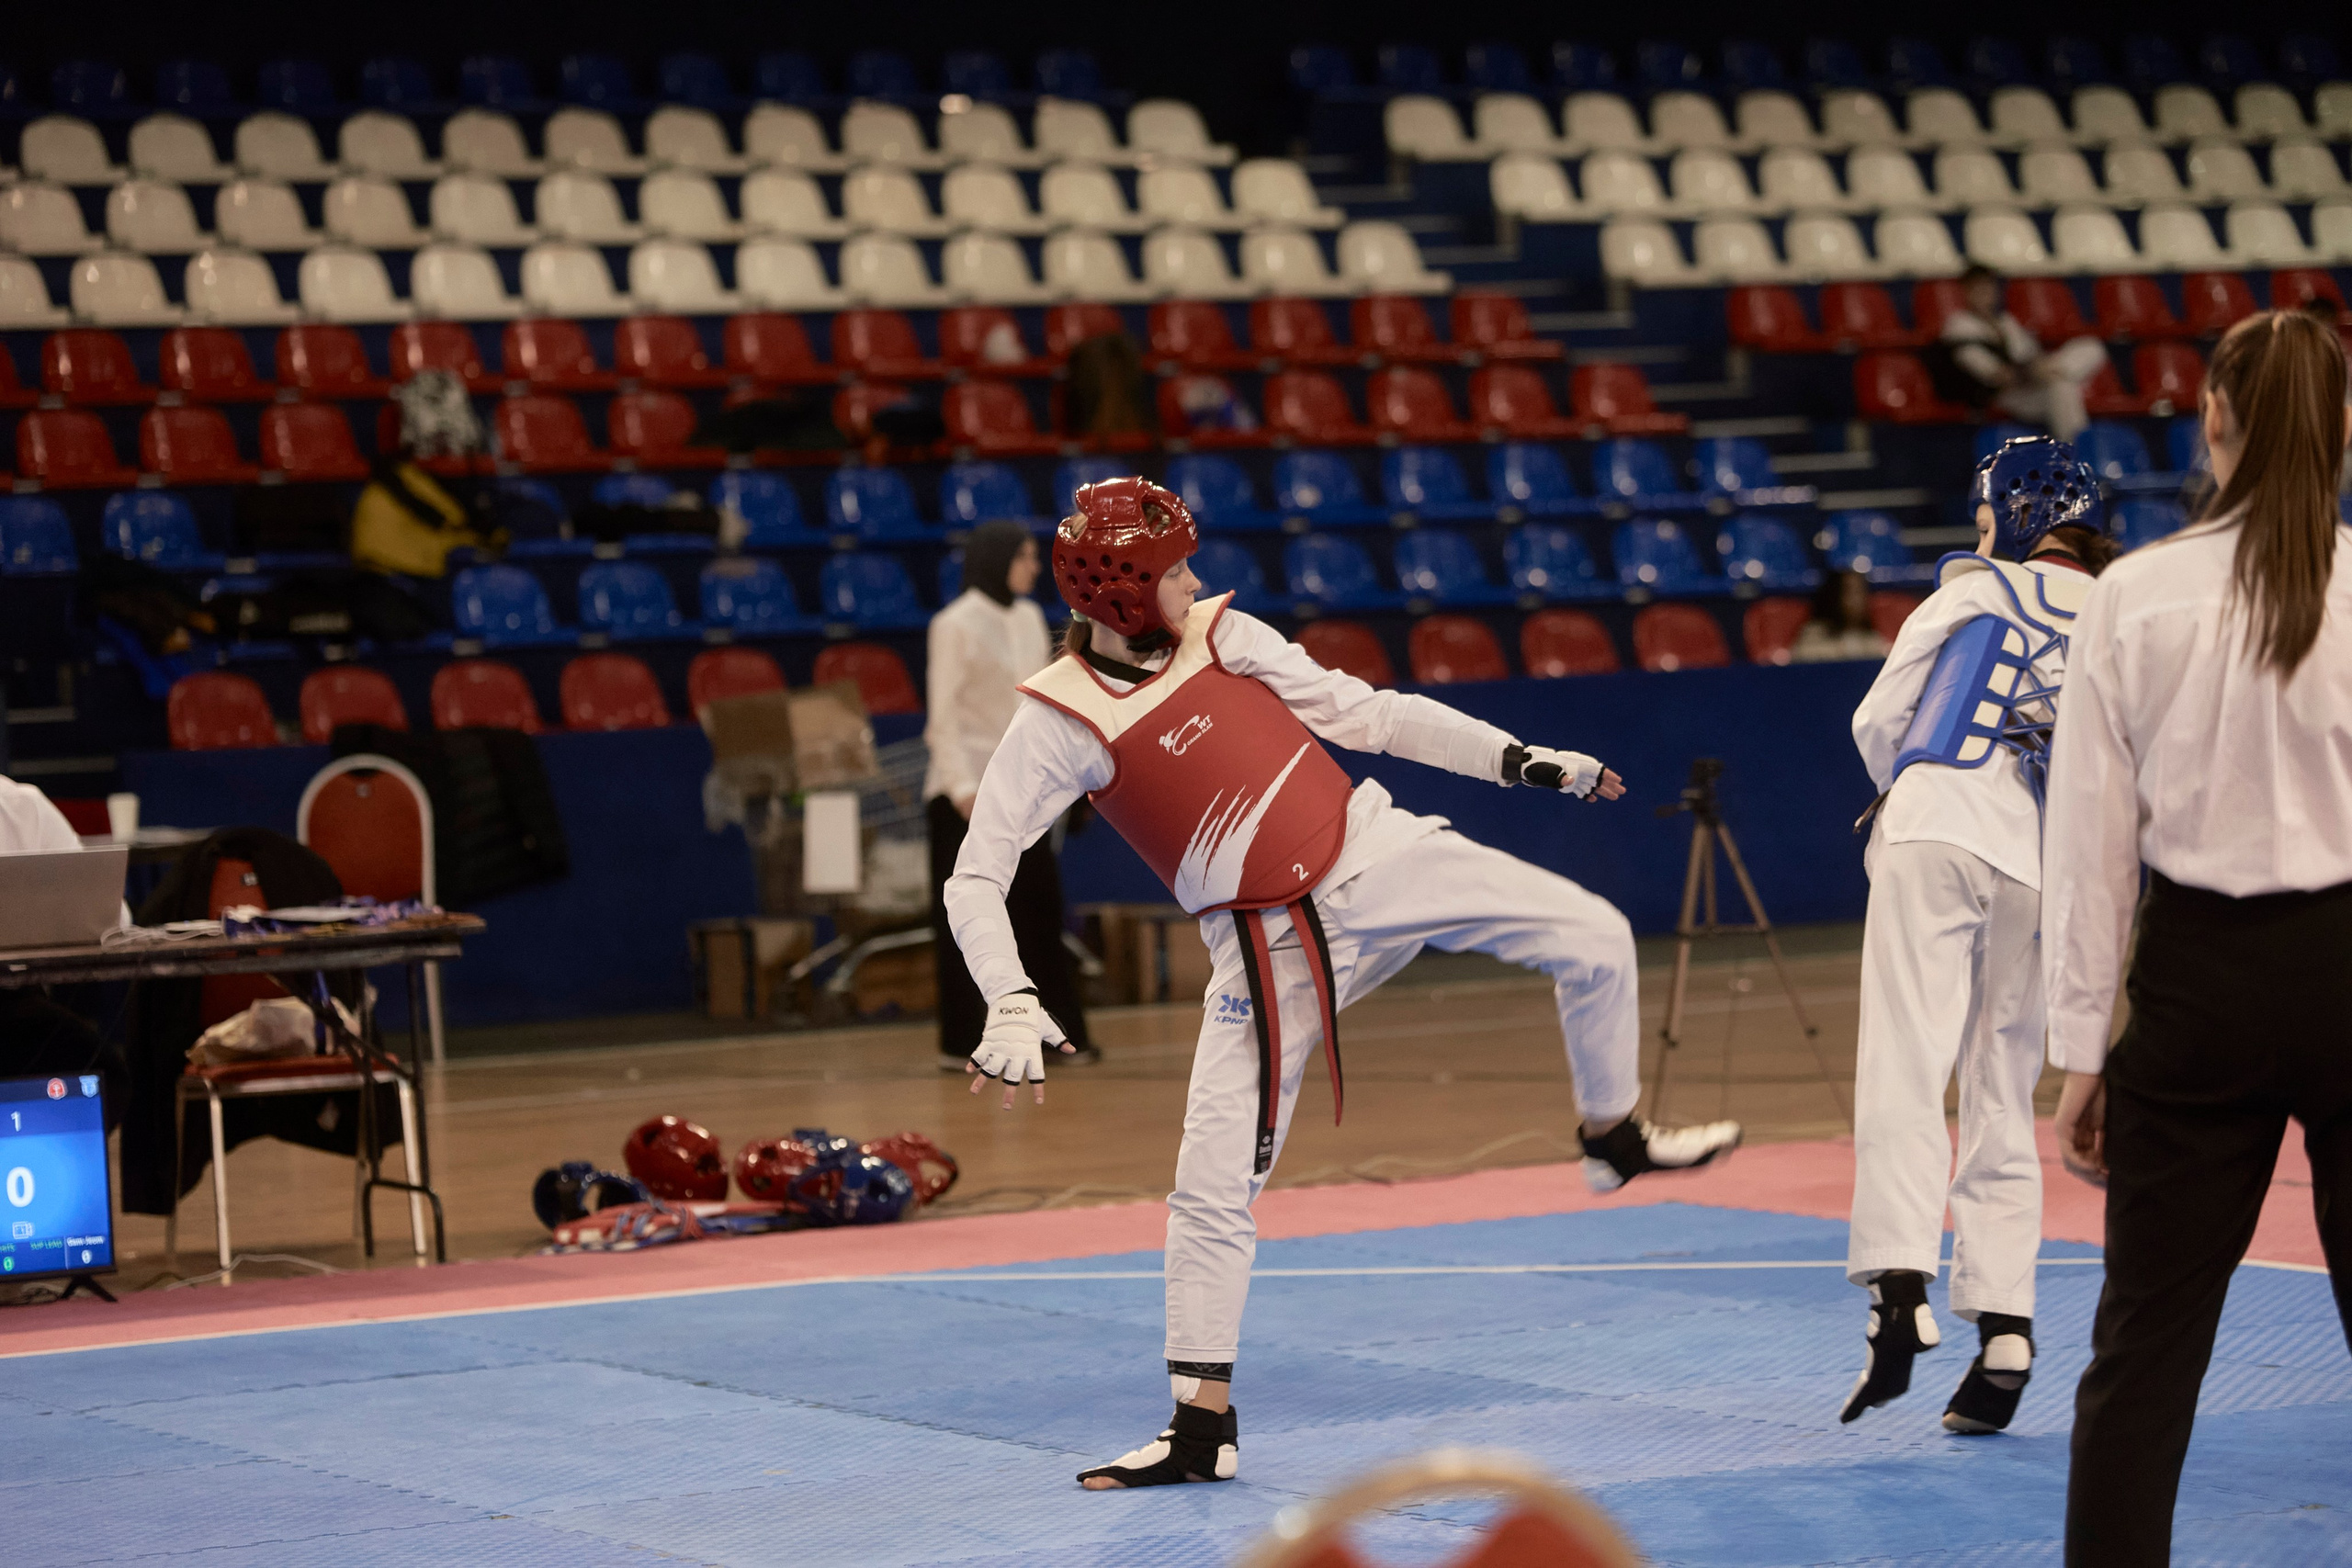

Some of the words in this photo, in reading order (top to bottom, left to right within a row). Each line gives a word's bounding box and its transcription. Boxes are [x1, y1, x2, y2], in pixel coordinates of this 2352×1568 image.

[1197, 715, 1210, 729] WT
[1187, 732, 1202, 746] GRAND
[1202, 722, 1213, 734] SLAM
[1292, 863, 1310, 882] 2
[999, 1007, 1029, 1015] KWON
[1214, 1015, 1248, 1024] KPNP
[11, 1111, 21, 1132] 1
[6, 1167, 35, 1208] 0
[3, 1257, 14, 1271] 0
[81, 1250, 92, 1264] 0
